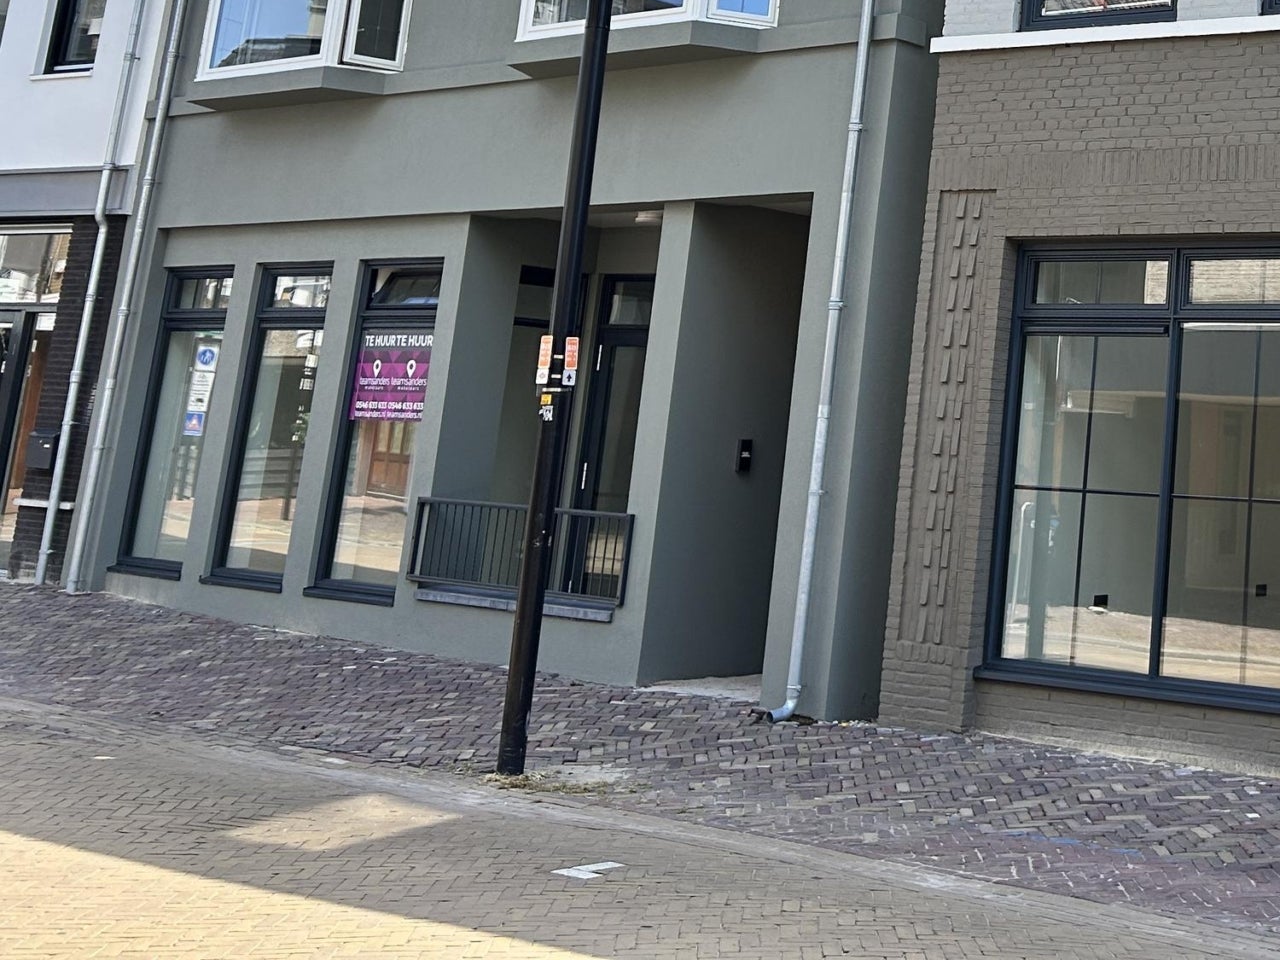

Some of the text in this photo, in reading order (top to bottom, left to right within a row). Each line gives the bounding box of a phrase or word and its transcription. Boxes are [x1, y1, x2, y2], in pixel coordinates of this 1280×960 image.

[365, 335, 396, 347] TE HUUR
[396, 334, 434, 346] TE HUUR
[391, 376, 427, 386] teamsanders
[388, 401, 402, 410] 0546
